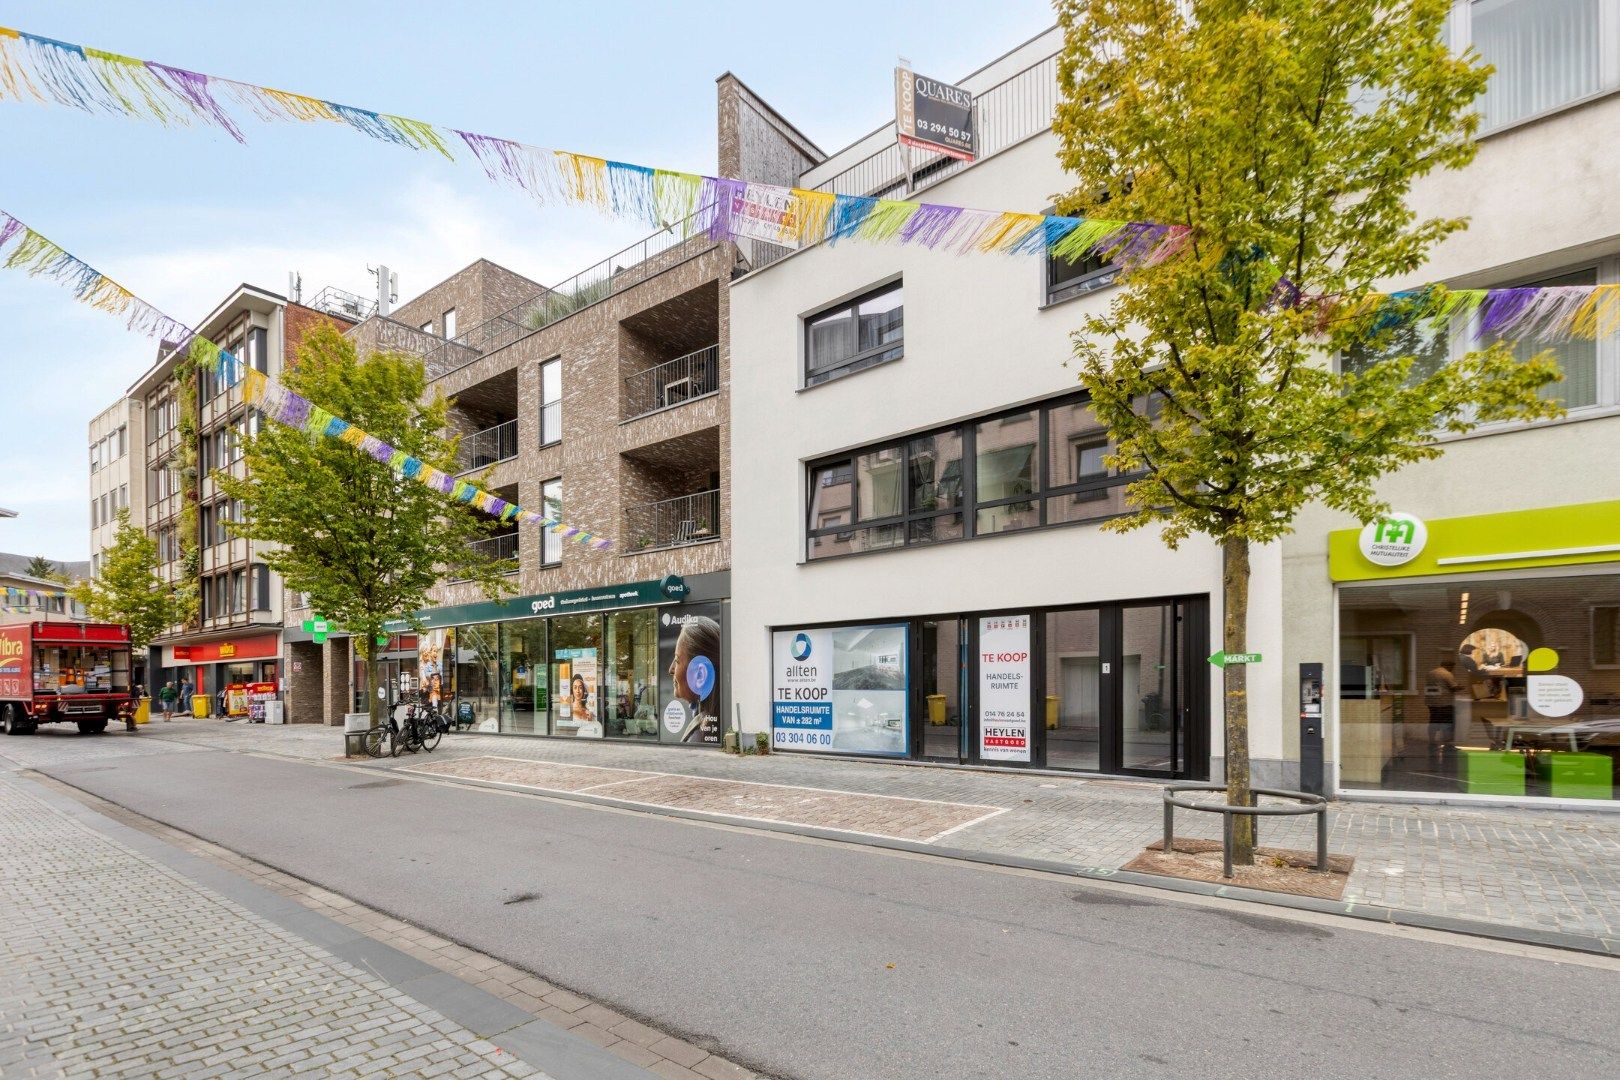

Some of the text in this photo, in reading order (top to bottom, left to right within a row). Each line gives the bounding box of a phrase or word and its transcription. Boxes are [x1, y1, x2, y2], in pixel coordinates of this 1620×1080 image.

[902, 72, 912, 112] KOOP
[915, 78, 971, 108] QUARES
[903, 116, 912, 130] TE
[917, 119, 971, 141] 03 294 50 57
[1371, 544, 1411, 552] CHRISTELIJKE
[667, 584, 683, 593] goed
[532, 596, 555, 613] goed
[671, 614, 698, 625] Audika
[0, 632, 23, 656] ibra
[982, 652, 1028, 662] TE KOOP
[786, 665, 817, 677] allten
[778, 688, 828, 700] TE KOOP
[776, 706, 830, 714] HANDELSRUIMTE
[782, 716, 795, 724] VAN
[801, 717, 812, 725] 282
[711, 725, 718, 733] je
[985, 728, 1025, 737] HEYLEN
[776, 732, 831, 745] 03 304 06 00
